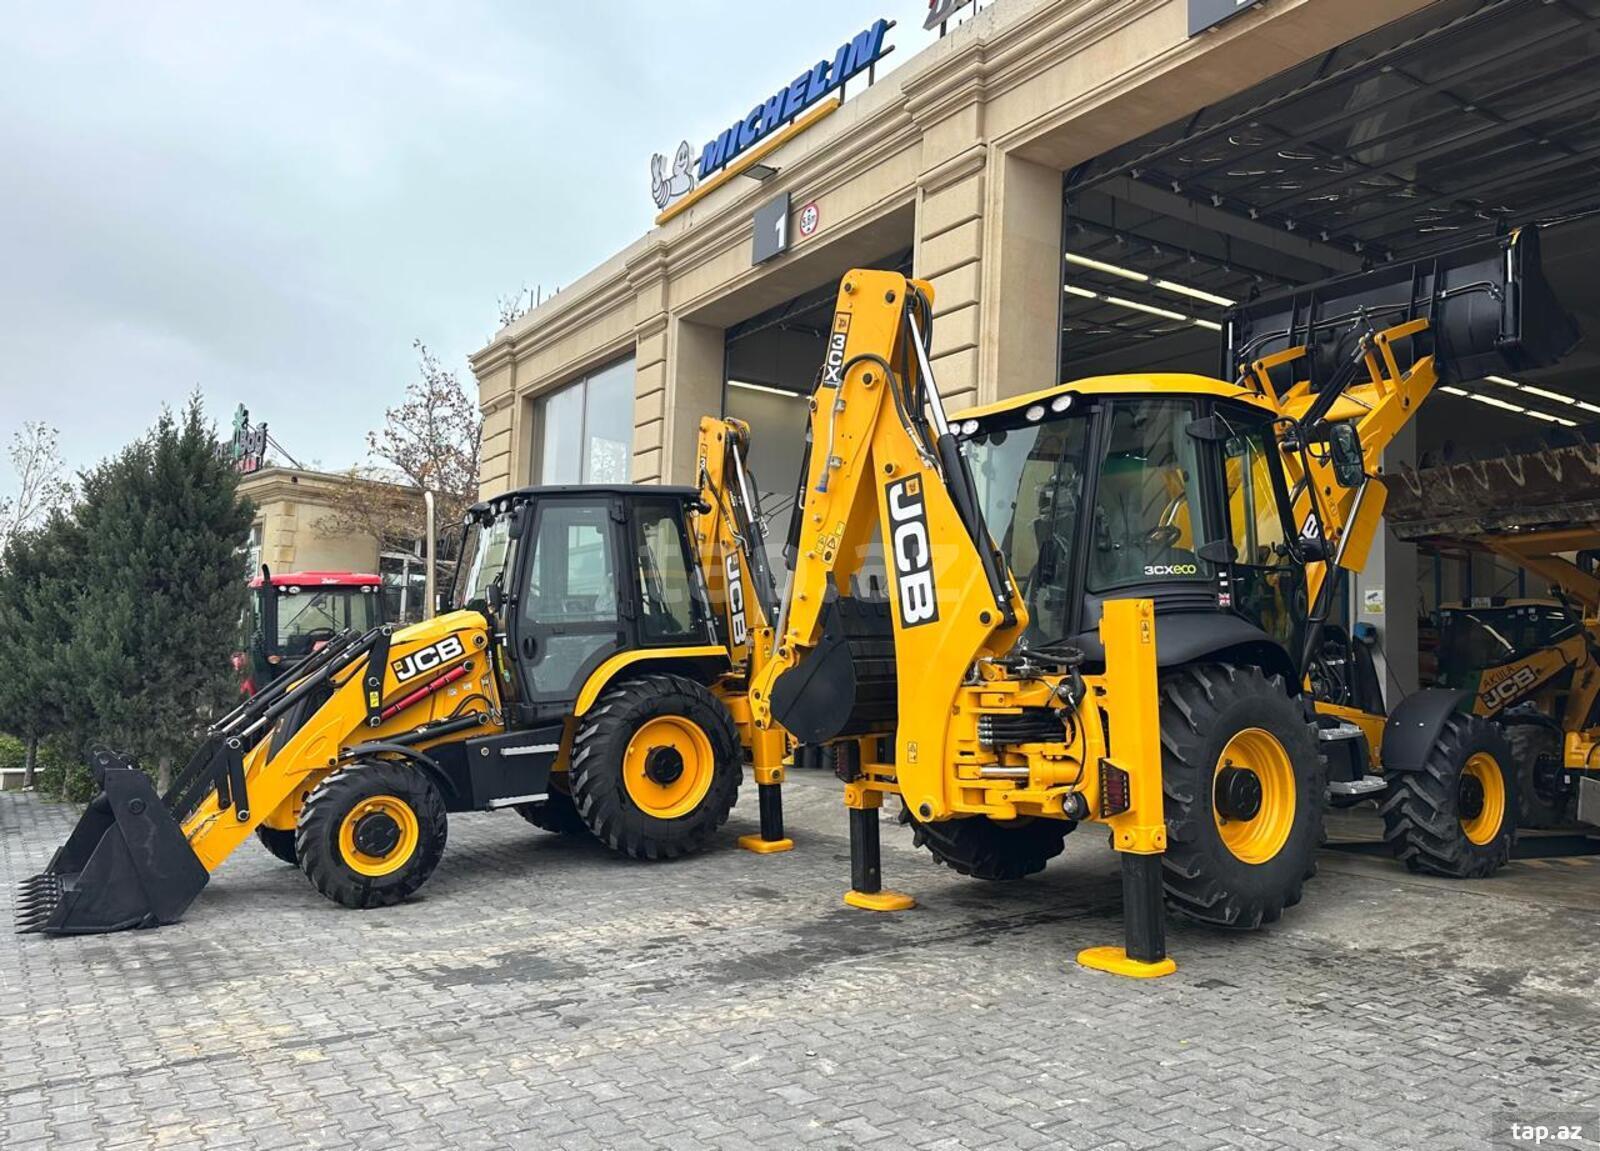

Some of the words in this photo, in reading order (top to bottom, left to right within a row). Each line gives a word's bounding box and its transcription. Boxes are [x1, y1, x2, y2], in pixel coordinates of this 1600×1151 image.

[699, 18, 887, 180] MICHELIN
[775, 213, 786, 248] 1
[825, 334, 846, 382] 3CX
[889, 482, 935, 624] JCB
[1144, 564, 1197, 576] 3CXeco
[726, 556, 746, 645] JCB
[396, 636, 463, 681] JCB
[1486, 666, 1537, 708] JCB
